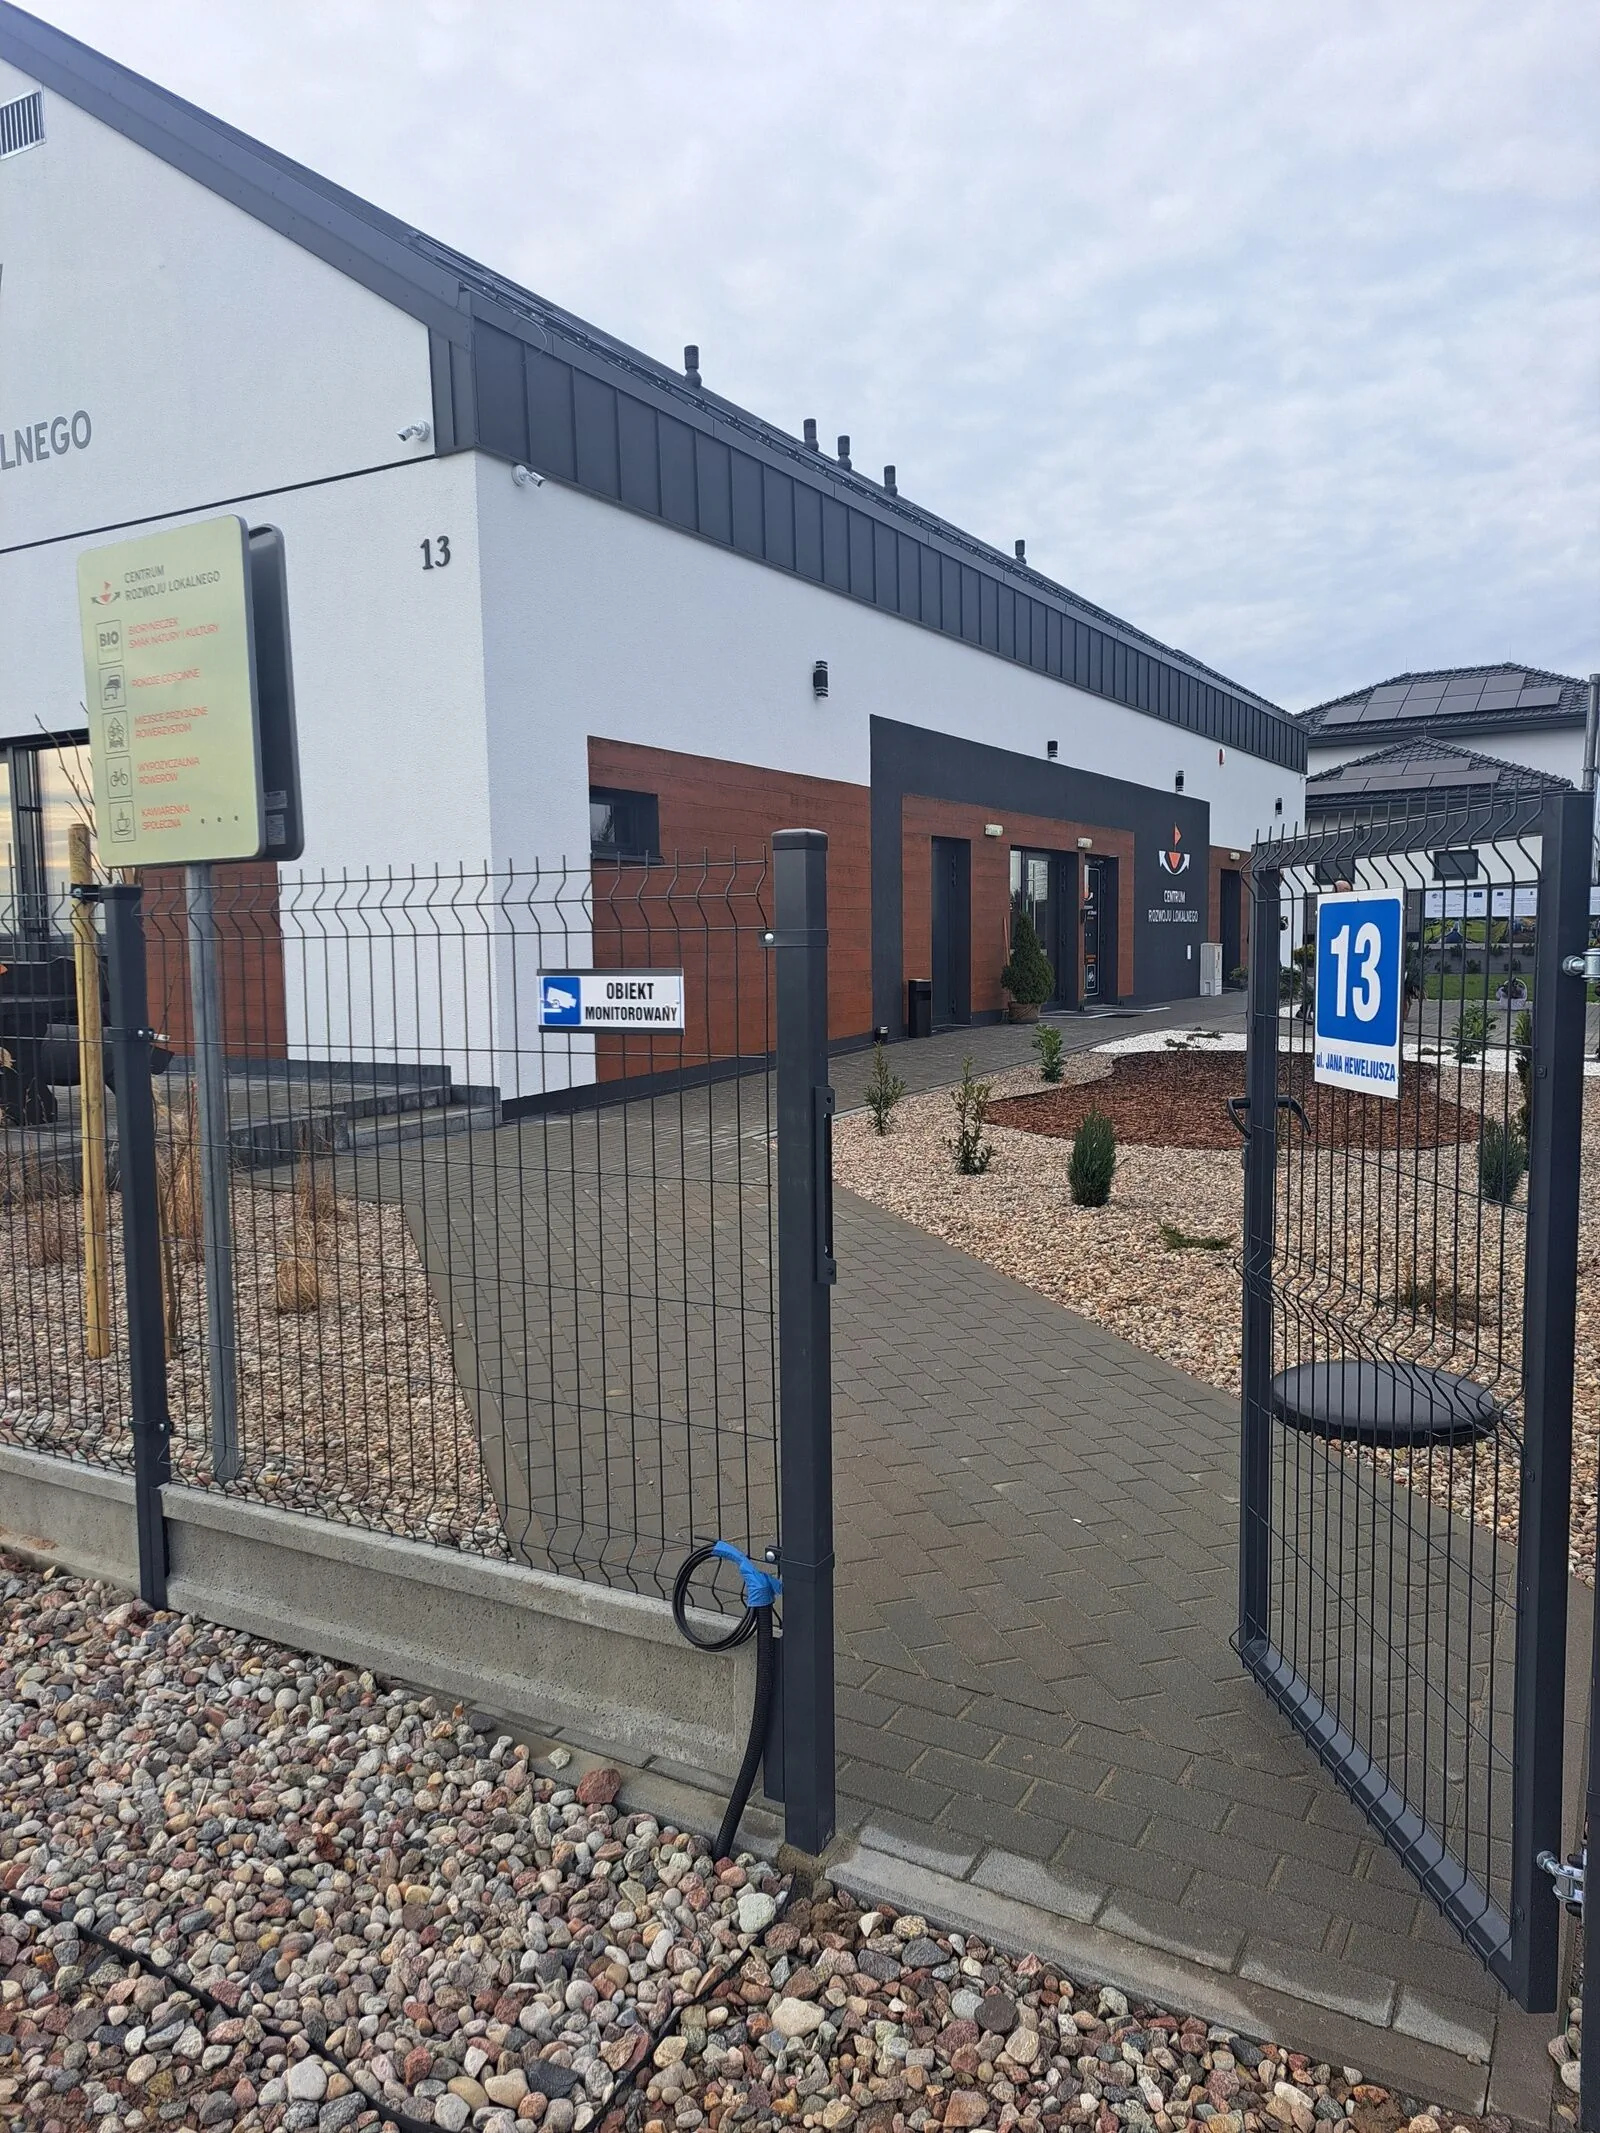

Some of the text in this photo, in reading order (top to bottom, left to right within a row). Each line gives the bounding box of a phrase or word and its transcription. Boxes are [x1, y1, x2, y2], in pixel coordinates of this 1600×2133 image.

[0, 410, 91, 469] LNEGO
[420, 535, 450, 570] 13
[124, 565, 165, 584] CENTRUM
[125, 570, 221, 601] ROZWOJU LOKALNEGO
[99, 631, 119, 647] BIO
[1163, 890, 1186, 903] CENTRUM
[1148, 909, 1199, 923] ROZWOJU LOKALNEGO
[1331, 922, 1382, 1022] 13
[606, 982, 655, 1000] OBIEKT
[585, 1006, 678, 1021] MONITOROWANY
[1316, 1053, 1396, 1081] ul. JANA HEWELIUSZA
